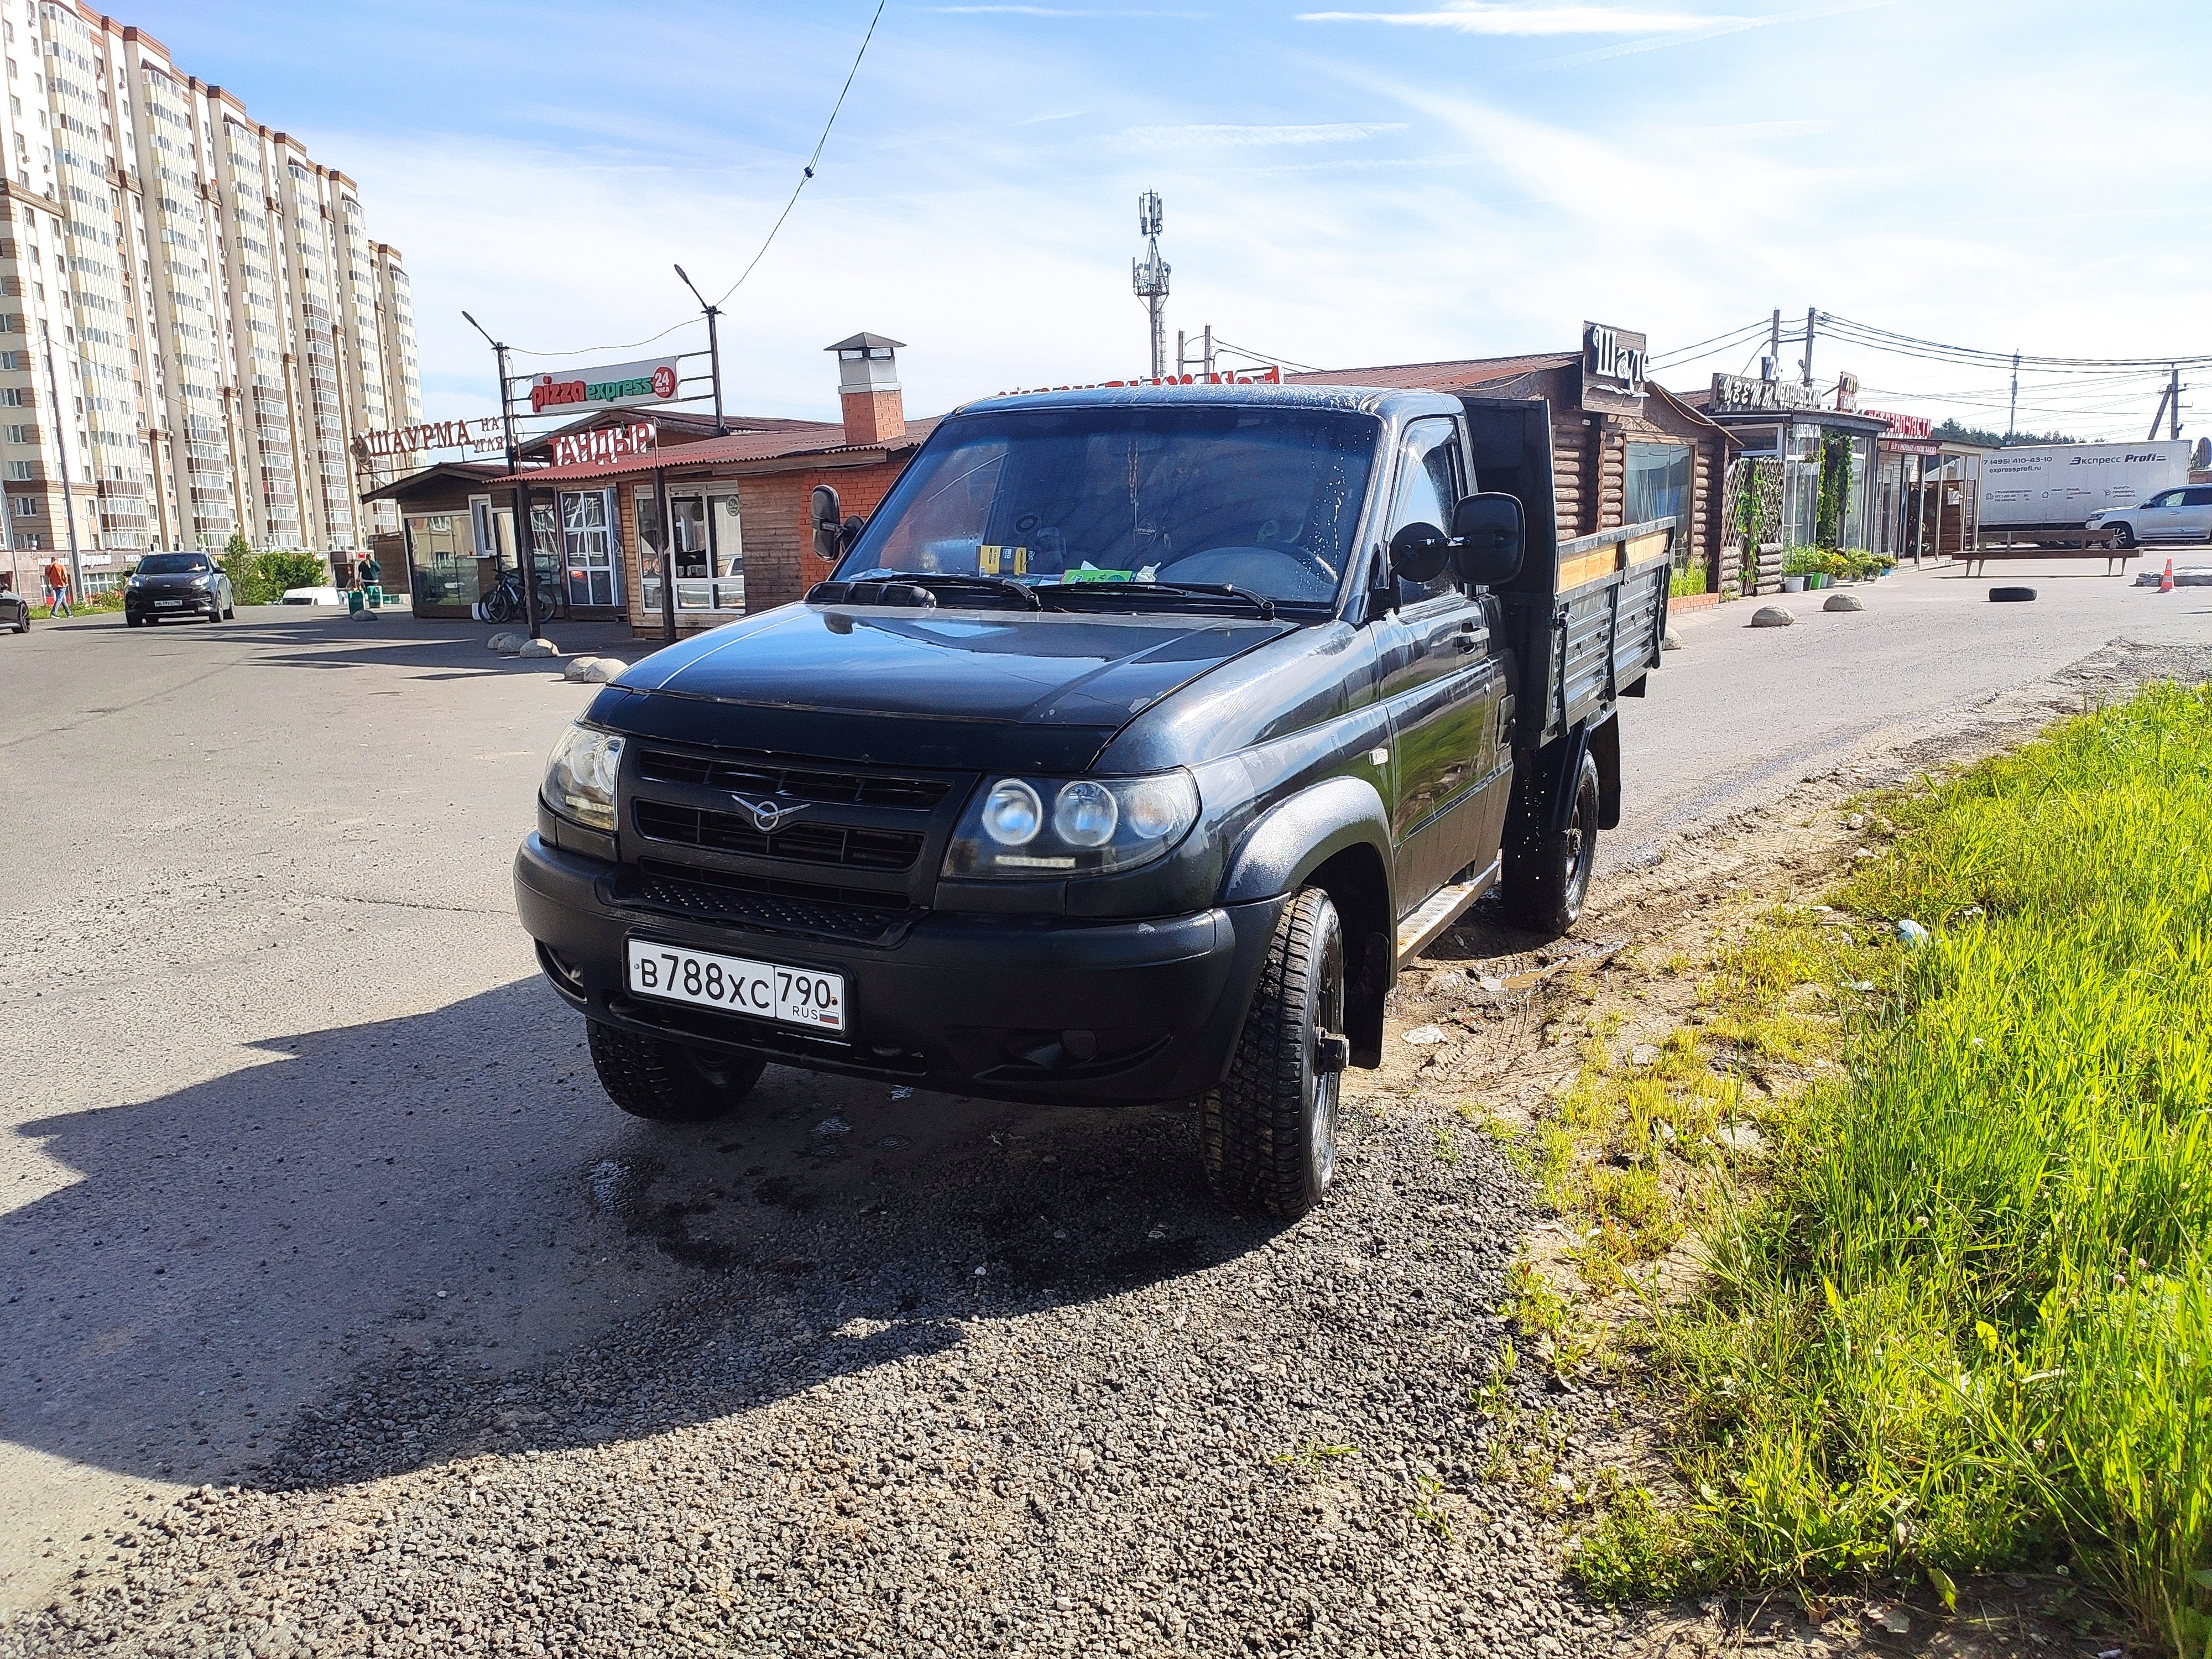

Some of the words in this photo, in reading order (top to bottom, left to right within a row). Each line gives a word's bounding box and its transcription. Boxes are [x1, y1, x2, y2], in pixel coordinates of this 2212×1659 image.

[1593, 325, 1651, 395] Шале
[655, 371, 670, 387] 24
[368, 419, 471, 456] ШАУРМА
[481, 416, 499, 431] НА
[1796, 423, 1814, 440] ЦВЕТЫ
[547, 422, 653, 467] ТАНДЫР
[2069, 456, 2121, 466] Экспресс
[2124, 453, 2156, 463] Profi
[81, 554, 112, 568] Верный
[777, 972, 831, 1009] 790
[792, 1005, 818, 1020] RUS
